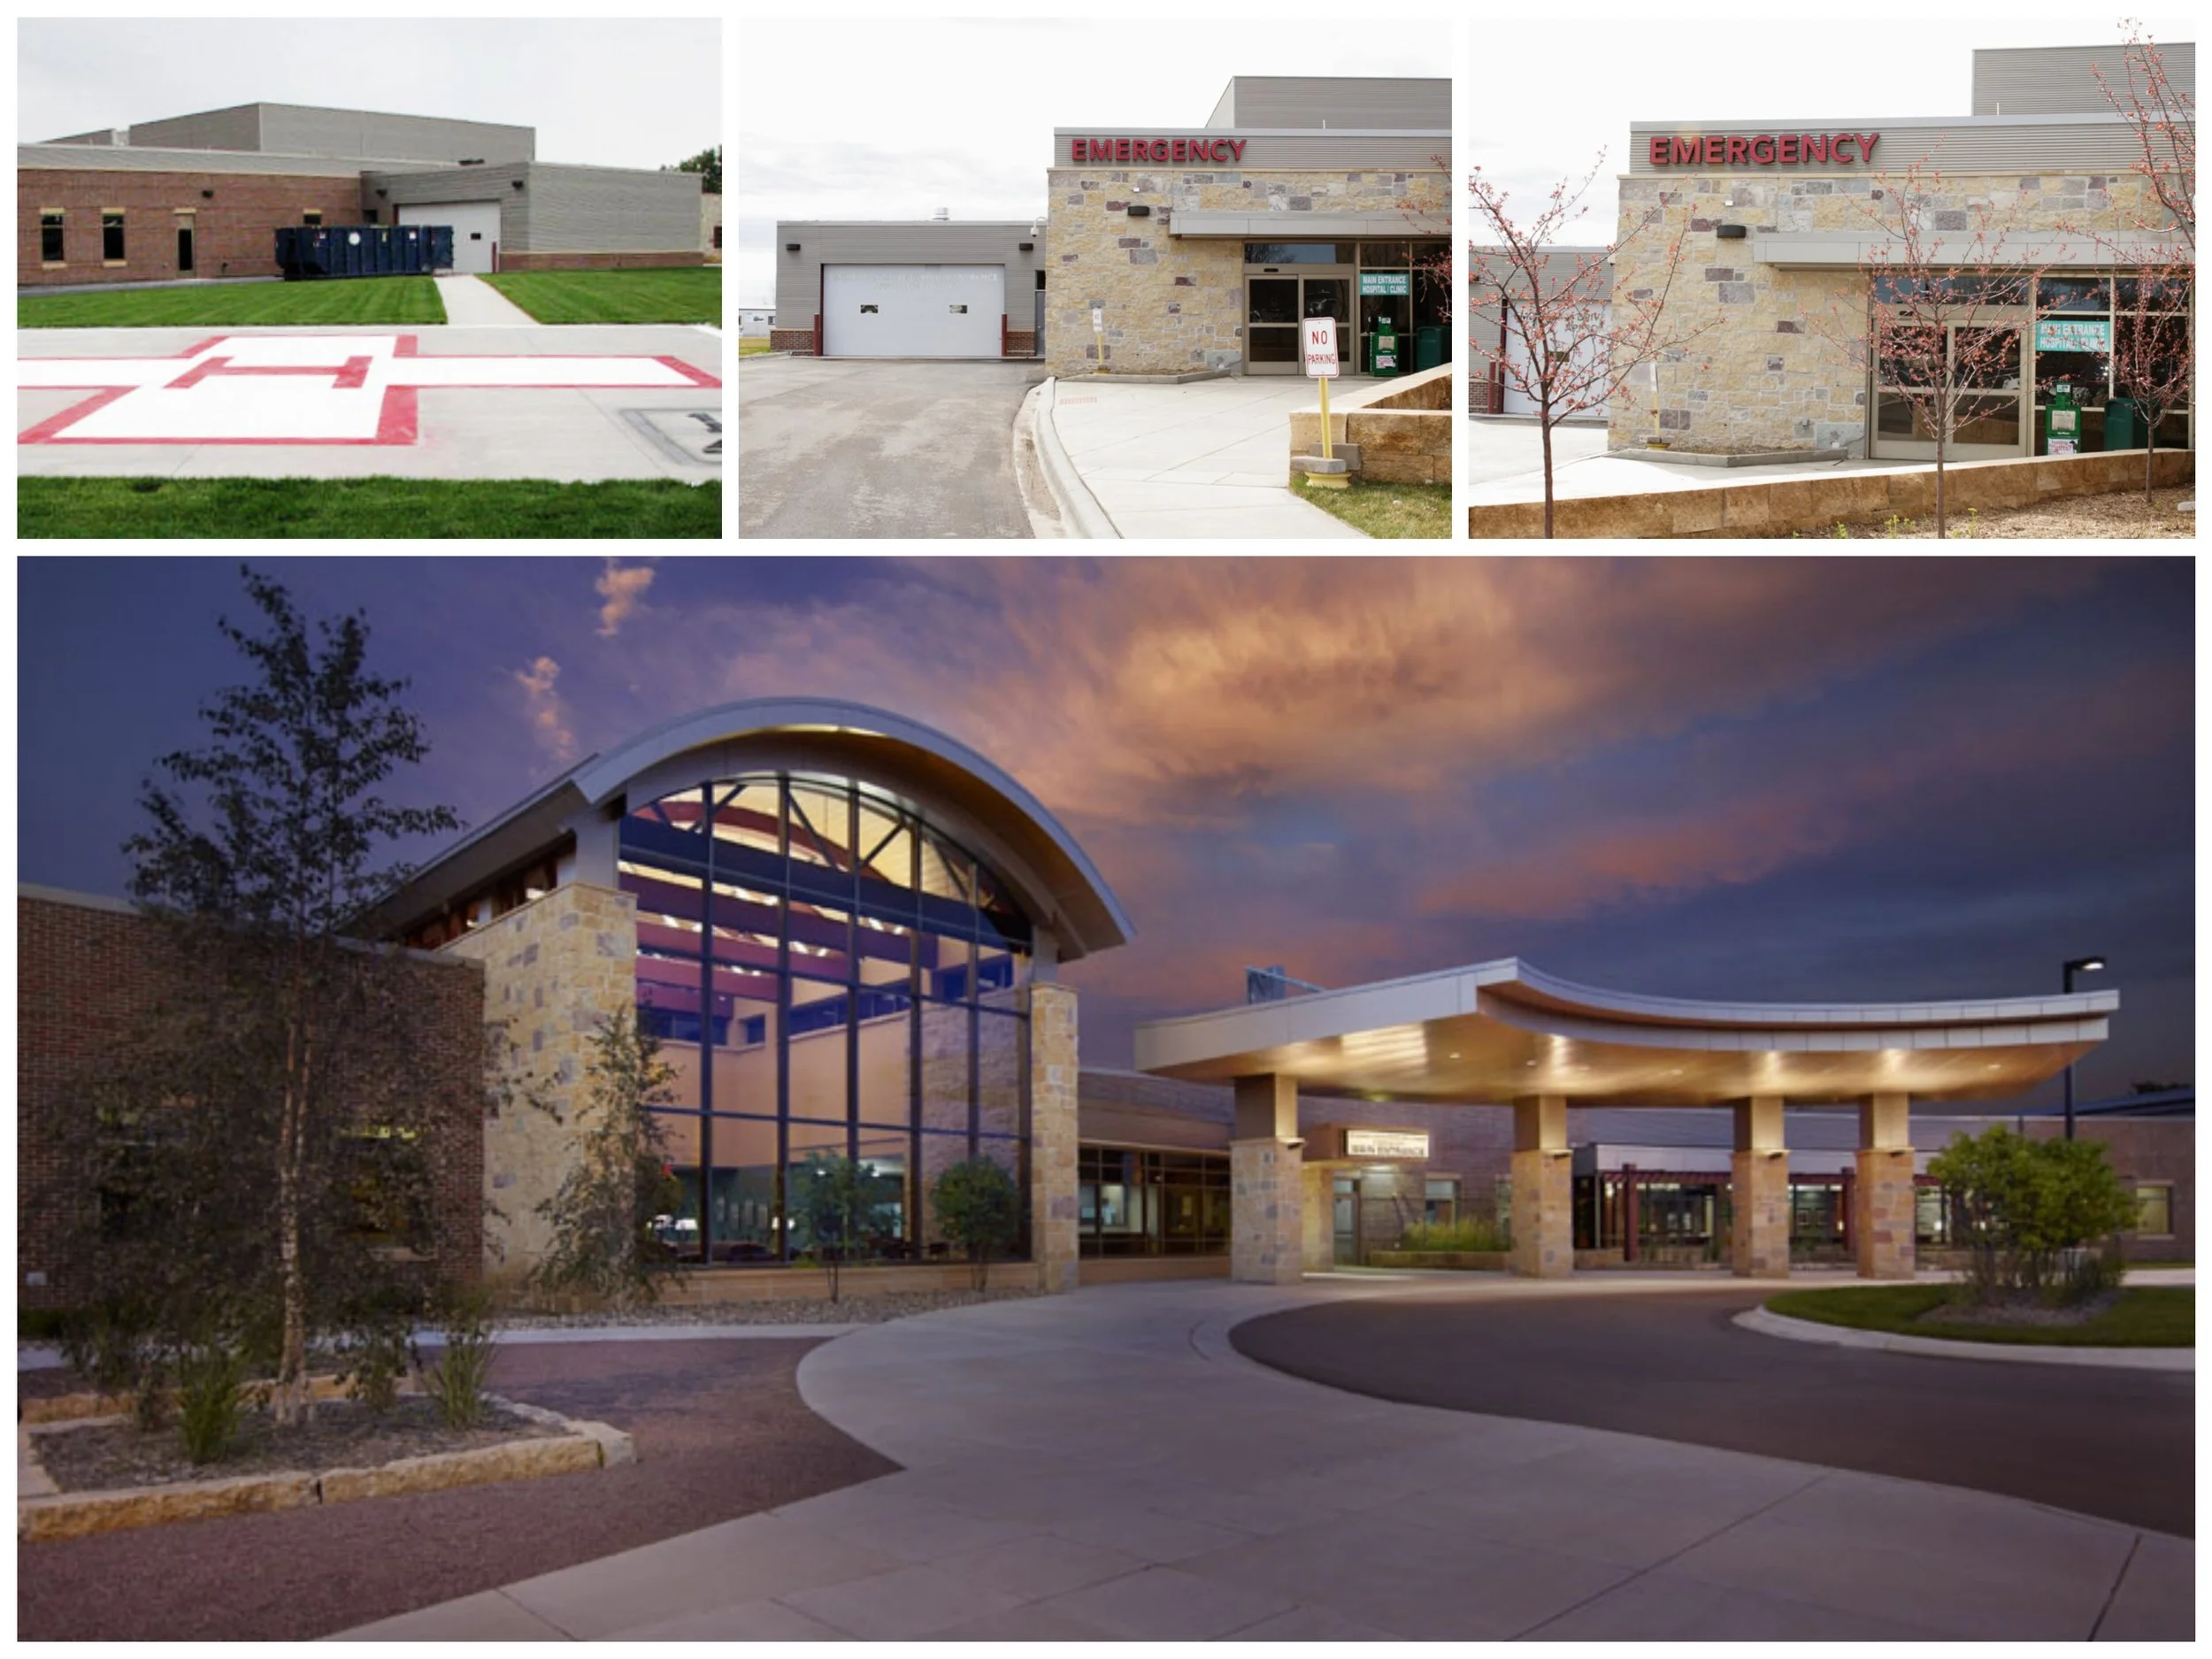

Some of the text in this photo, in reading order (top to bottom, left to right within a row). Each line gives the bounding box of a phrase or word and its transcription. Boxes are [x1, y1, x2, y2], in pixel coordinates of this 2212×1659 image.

[1071, 138, 1248, 162] EMERGENCY
[1649, 133, 1880, 165] EMERGENCY
[1363, 275, 1406, 284] MAIN ENTRANCE
[1363, 285, 1386, 294] HOSPITAL
[1389, 285, 1407, 294] CLINIC
[1311, 330, 1328, 345] NO
[1307, 353, 1335, 365] PARKING
[162, 356, 373, 388] H
